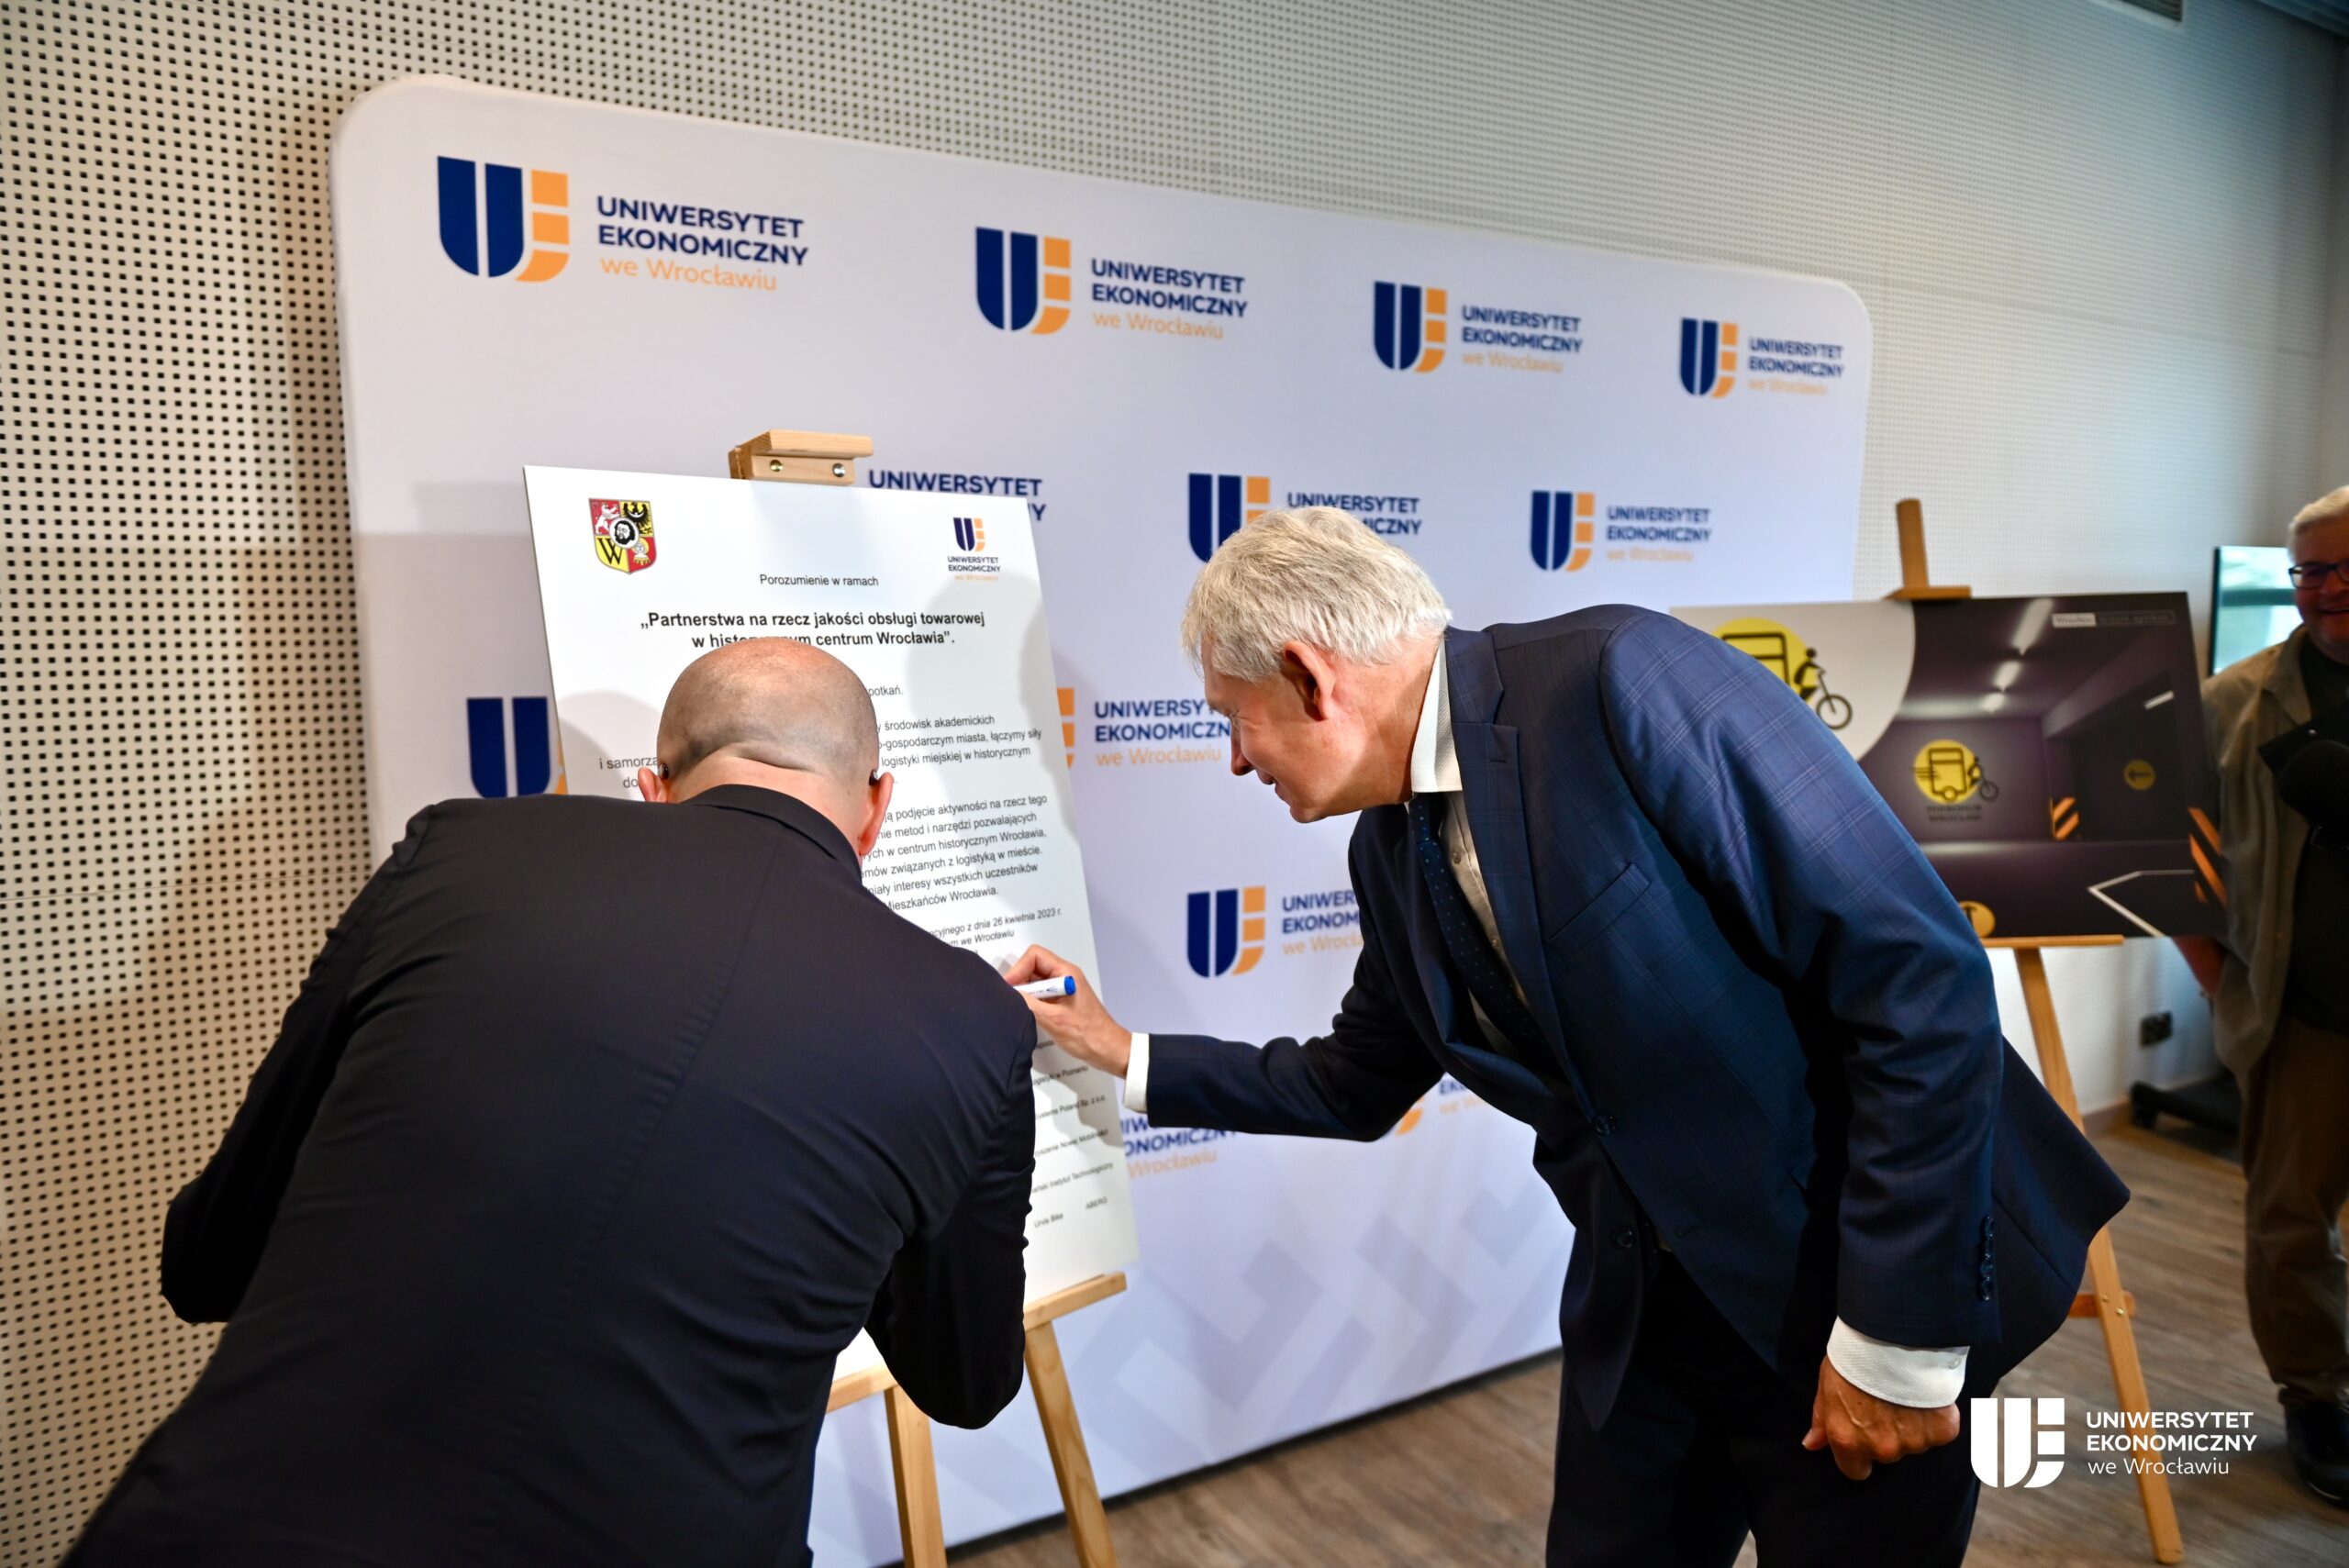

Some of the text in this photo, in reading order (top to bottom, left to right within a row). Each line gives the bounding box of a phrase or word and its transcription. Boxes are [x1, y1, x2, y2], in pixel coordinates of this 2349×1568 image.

[597, 195, 804, 239] UNIWERSYTET
[598, 224, 808, 266] EKONOMICZNY
[601, 257, 777, 291] we Wrocławiu
[1091, 258, 1245, 294] UNIWERSYTET
[1092, 283, 1248, 317] EKONOMICZNY
[1093, 312, 1224, 339] we Wrocławiu
[1462, 306, 1582, 332] UNIWERSYTET
[1462, 327, 1583, 353] EKONOMICZNY
[1749, 337, 1843, 359] UNIWERSYTET
[1749, 356, 1844, 378] EKONOMICZNY
[869, 469, 1042, 496] UNIWERSYTET
[1608, 506, 1710, 524] UNIWERSYTET
[1608, 526, 1711, 542] EKONOMICZNY
[760, 573, 879, 586] Porozumienie w ramach
[948, 564, 1001, 573] EKONOMICZNY
[750, 615, 767, 626] na
[773, 615, 810, 626] rzecz
[814, 612, 864, 628] jakości
[868, 612, 918, 628] obsługi
[920, 612, 985, 627] towarowej
[692, 638, 705, 648] w
[816, 633, 874, 645] centrum
[869, 685, 904, 696] potkań.
[885, 720, 931, 731] środowisk
[934, 715, 995, 728] akademickich
[1095, 722, 1231, 742] EKONOMICZN
[599, 758, 603, 769] i
[956, 733, 988, 743] miasta,
[990, 731, 1025, 742] łączymy
[1028, 728, 1041, 740] siły
[882, 754, 919, 768] logistyki
[922, 751, 962, 764] miejskiej
[974, 747, 1030, 760] historycznym
[1096, 744, 1222, 767] we Wrocławiu
[896, 806, 936, 820] podjęcie
[938, 800, 987, 815] aktywności
[990, 800, 1001, 808] na
[1003, 798, 1026, 807] rzecz
[1029, 795, 1047, 806] tego
[895, 825, 924, 837] metod
[927, 823, 930, 833] i
[932, 818, 971, 833] narzędzi
[974, 812, 1037, 828] pozwalających
[897, 843, 936, 855] centrum
[939, 835, 997, 850] historycznym
[891, 858, 945, 874] związanych
[948, 858, 953, 866] z
[956, 851, 996, 867] logistyką
[894, 878, 931, 892] interesy
[933, 871, 983, 886] wszystkich
[985, 862, 1038, 878] uczestników
[1283, 890, 1356, 912] UNIWER
[974, 919, 991, 929] dnia
[993, 917, 1003, 927] 26
[1005, 912, 1035, 924] kwietnia
[1037, 907, 1055, 919] 2023
[961, 937, 972, 946] we
[974, 930, 1015, 943] Wrocławiu
